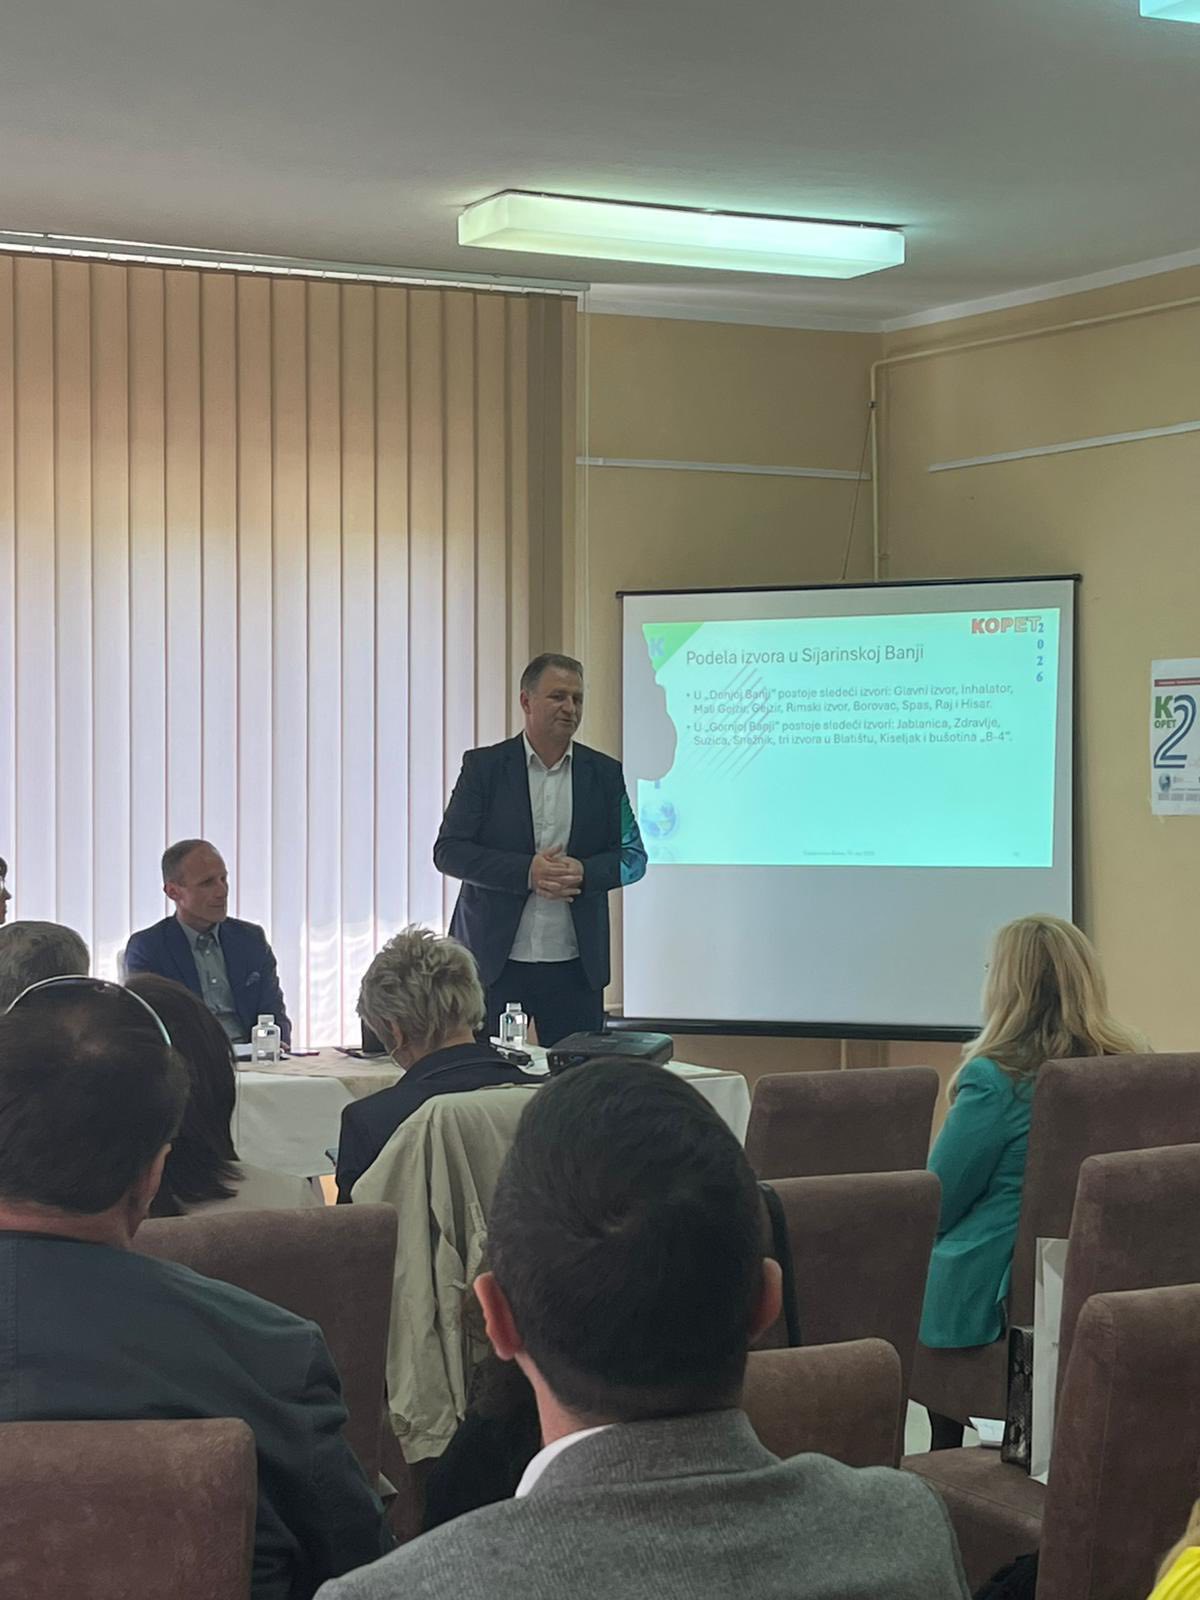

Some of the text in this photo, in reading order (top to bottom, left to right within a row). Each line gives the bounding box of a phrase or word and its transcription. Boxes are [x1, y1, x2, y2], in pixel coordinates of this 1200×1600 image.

[971, 615, 1042, 635] KOPET
[686, 643, 924, 666] Podela izvora u Sijarinskoj Banji
[693, 690, 702, 700] U
[778, 688, 817, 701] postoje
[894, 685, 929, 696] Glavni
[961, 683, 1014, 695] Inhalator,
[694, 703, 715, 714] Mali
[786, 701, 821, 713] Rimski
[823, 701, 851, 713] izvor,
[853, 701, 900, 713] Borovac,
[902, 699, 933, 712] Spas,
[935, 698, 953, 711] Raj
[693, 722, 702, 732] U
[782, 719, 821, 732] postoje
[897, 718, 952, 731] Jablanica,
[954, 717, 1001, 730] Zdravlje,
[778, 734, 789, 744] tri
[791, 733, 821, 744] izvora
[824, 735, 831, 744] u
[880, 732, 922, 744] Kiseljak
[929, 730, 977, 743] bušotina
